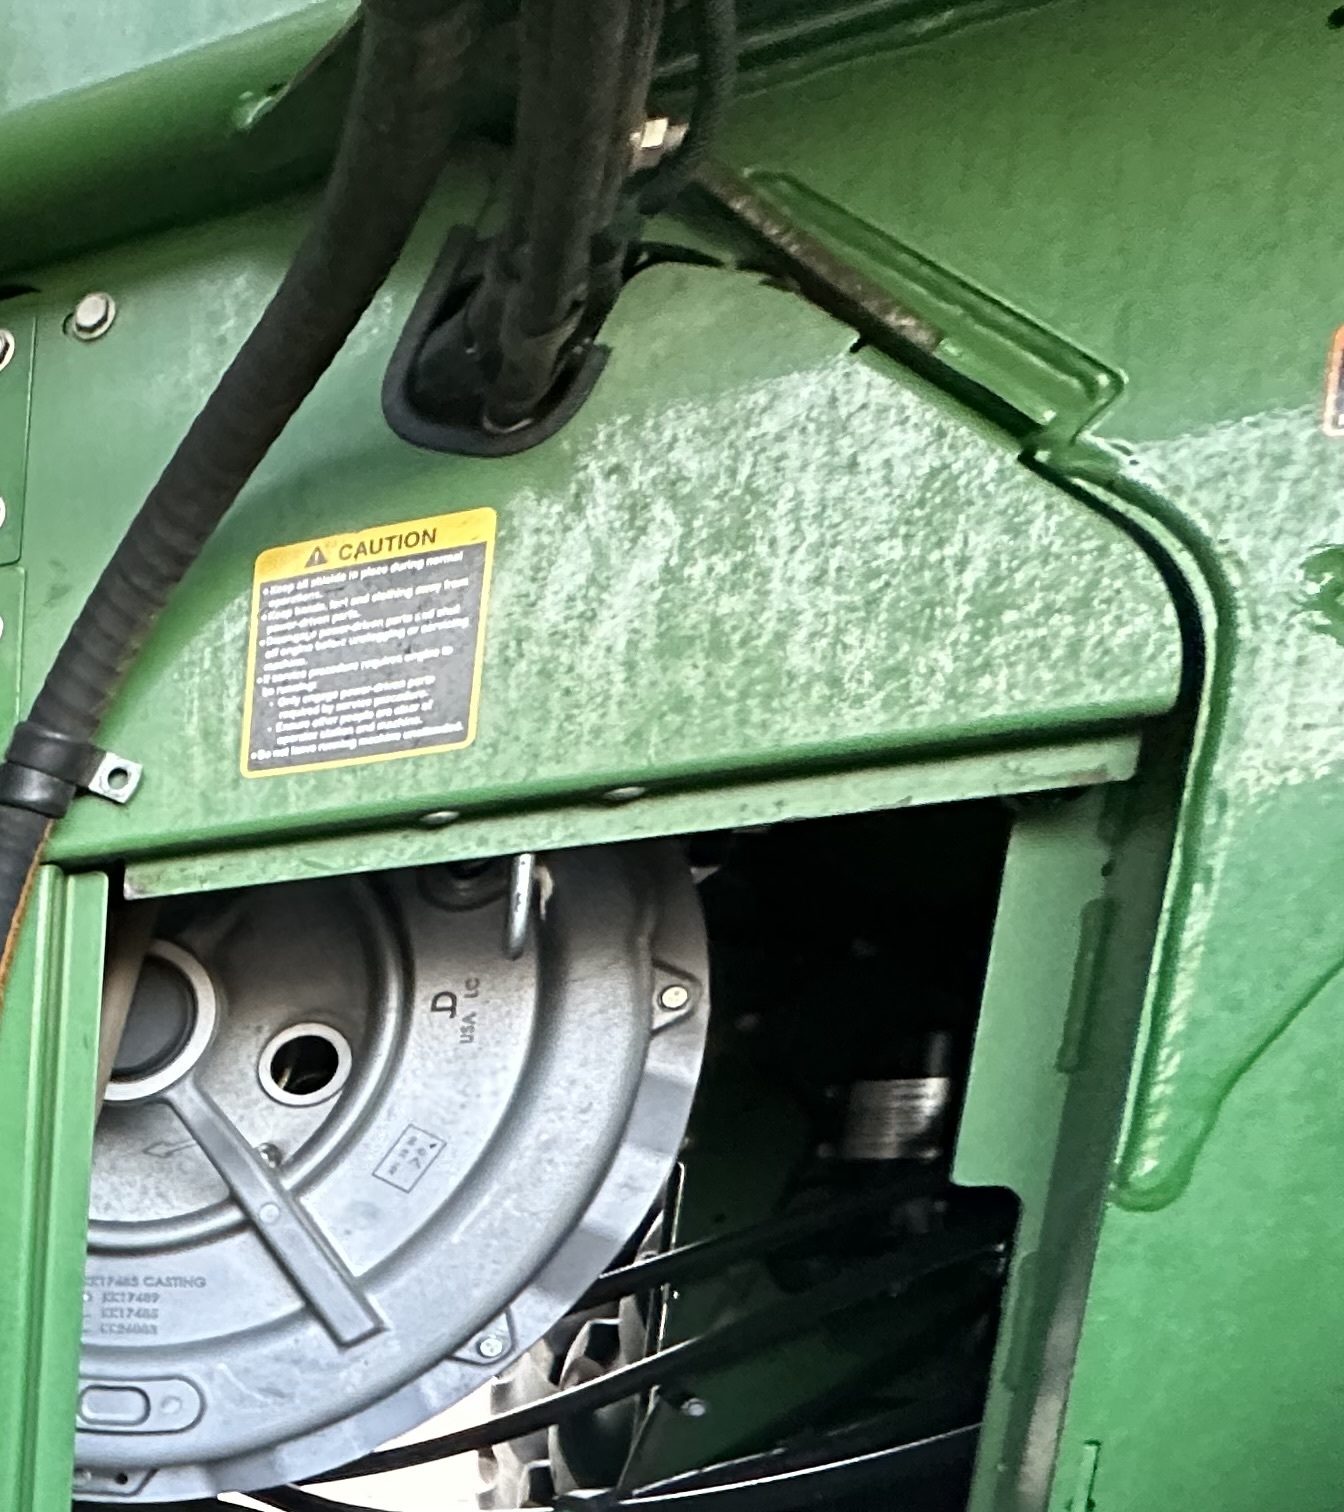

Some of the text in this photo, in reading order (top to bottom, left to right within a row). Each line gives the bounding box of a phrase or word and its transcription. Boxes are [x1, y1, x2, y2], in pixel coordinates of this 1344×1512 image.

[338, 527, 437, 562] CAUTION
[459, 1012, 477, 1044] USA
[143, 1276, 207, 1289] CASTING
